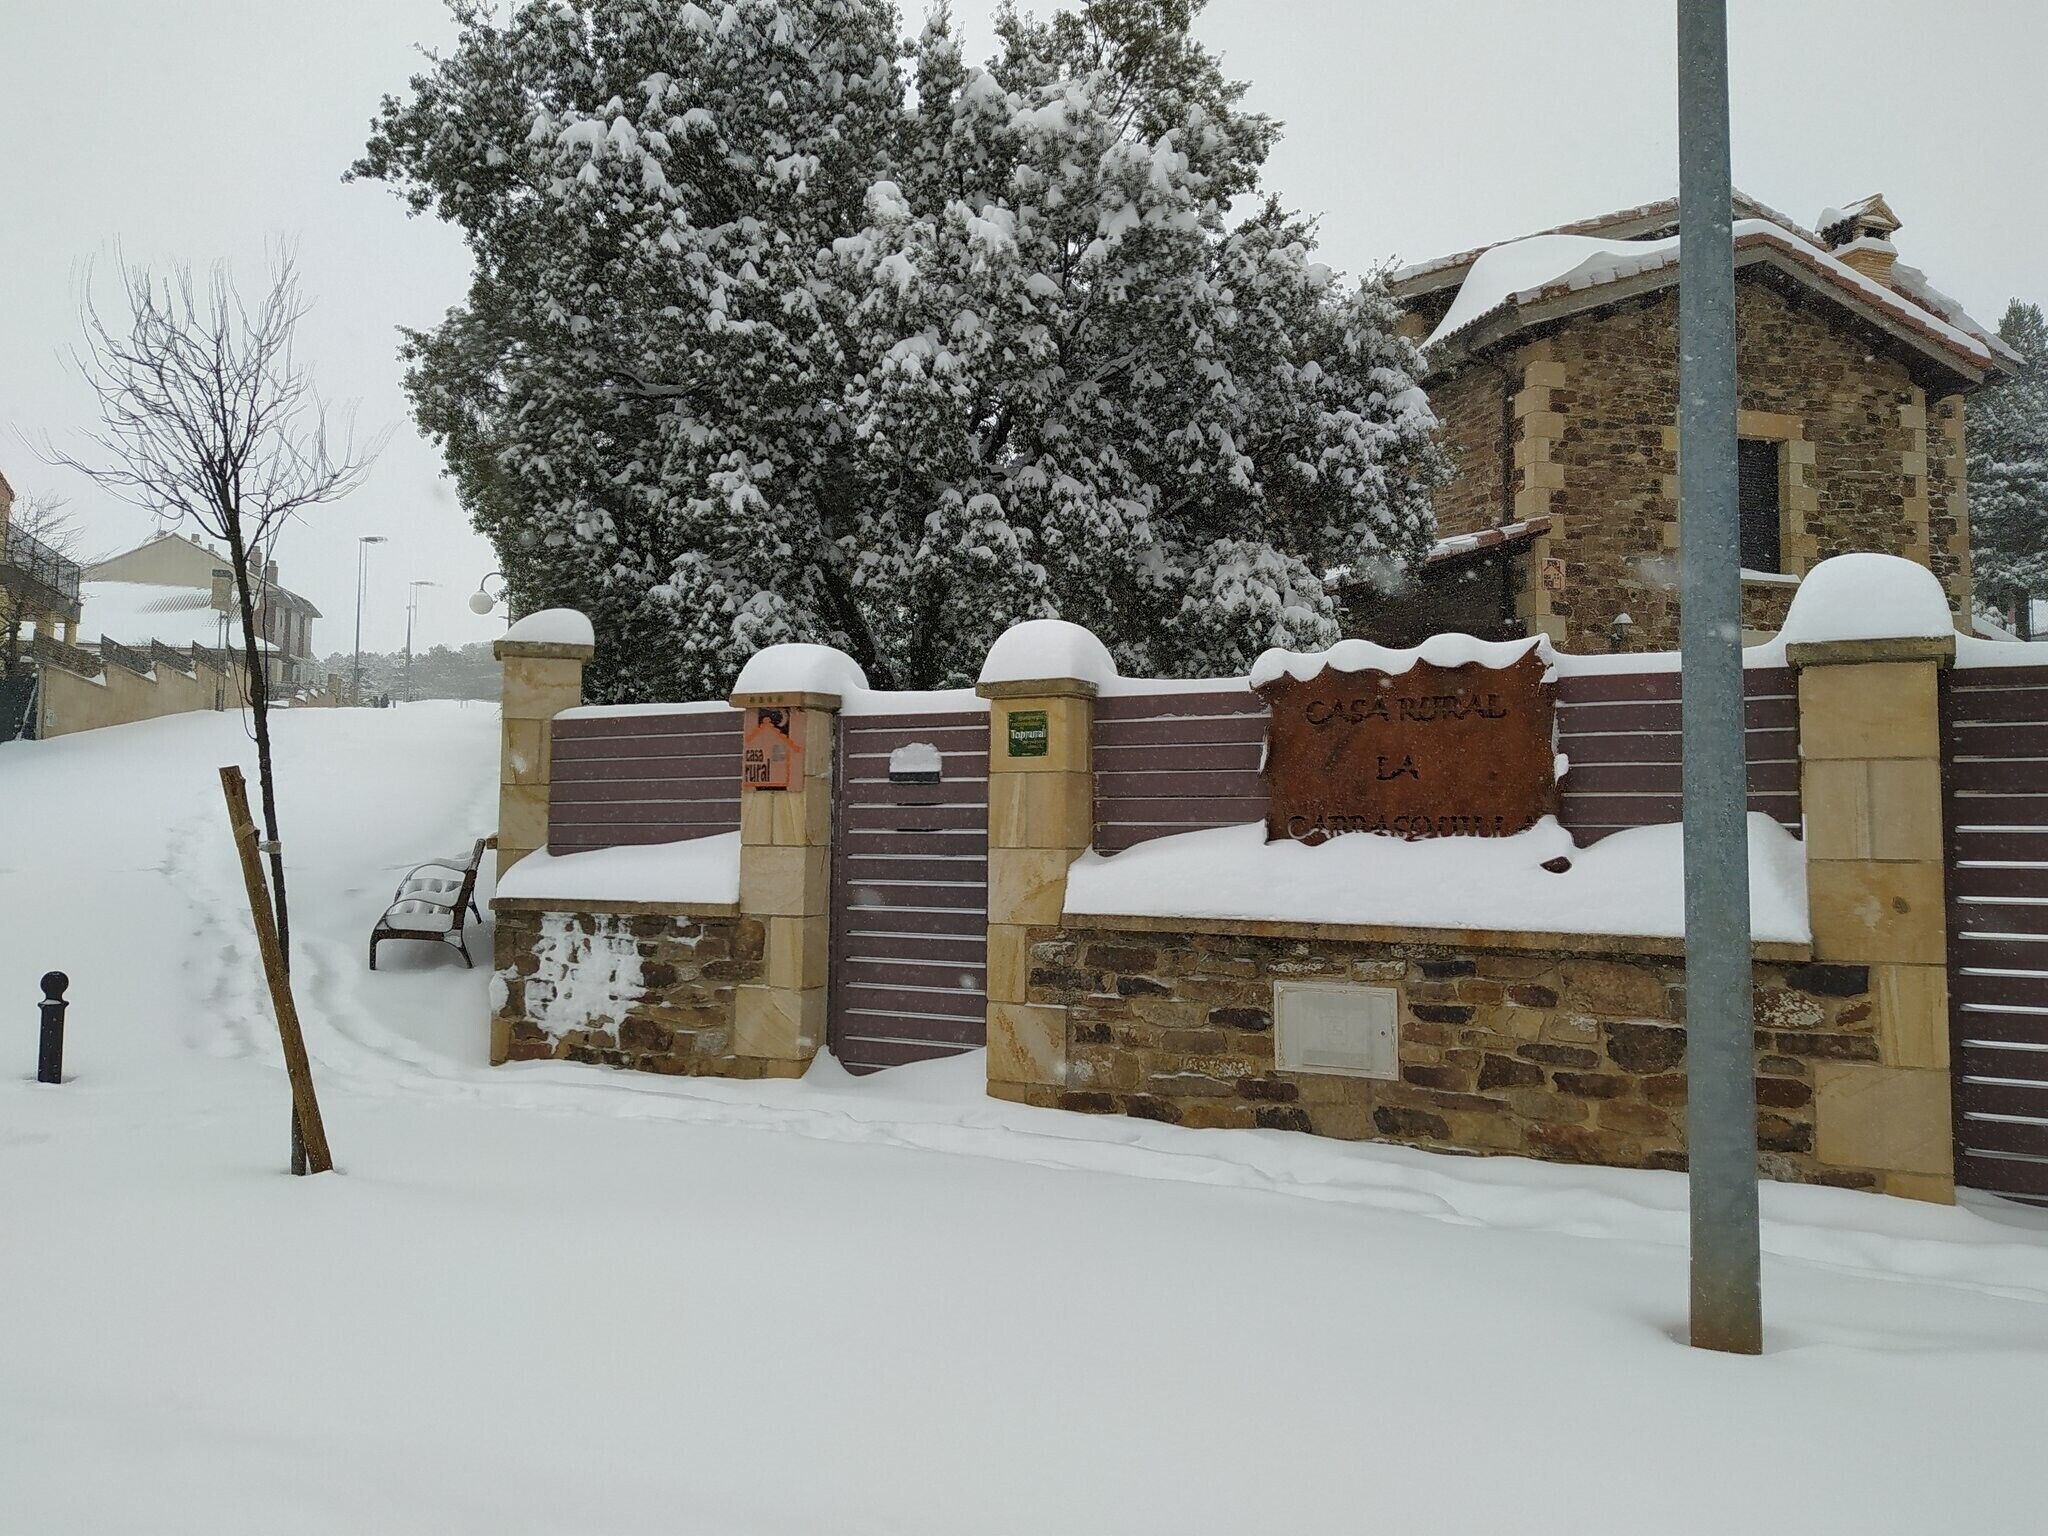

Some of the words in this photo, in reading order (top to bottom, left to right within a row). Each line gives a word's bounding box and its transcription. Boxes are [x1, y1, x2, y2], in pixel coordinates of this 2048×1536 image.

[1306, 697, 1390, 725] CASA
[1397, 693, 1508, 722] RURAL
[1010, 728, 1046, 740] Toprural
[745, 749, 764, 762] casa
[1376, 754, 1419, 781] LA
[745, 758, 770, 782] rural
